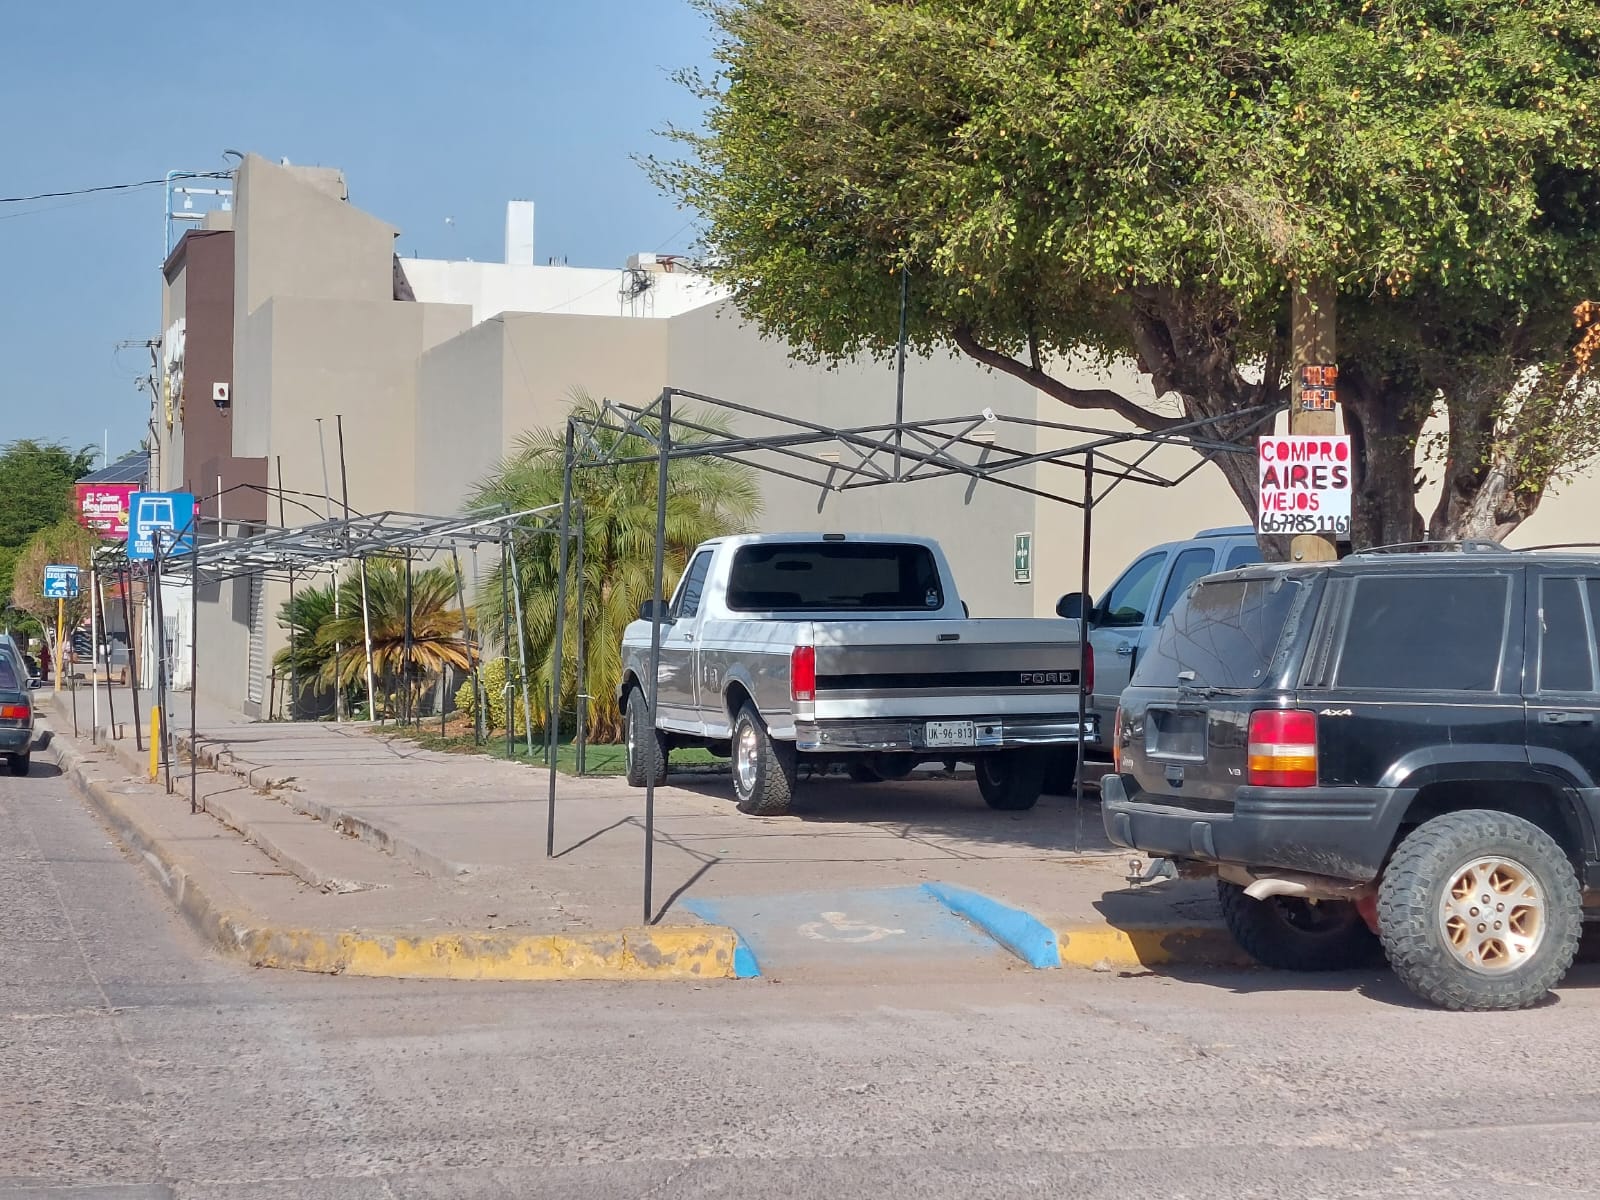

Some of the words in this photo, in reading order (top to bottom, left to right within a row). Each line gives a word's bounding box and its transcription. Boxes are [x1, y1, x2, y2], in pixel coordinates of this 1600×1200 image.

[1261, 441, 1349, 462] COMPRO
[1261, 464, 1349, 490] AIRES
[1261, 492, 1320, 511] VIEJOS
[1020, 672, 1072, 684] FORD
[928, 727, 973, 740] UK-96-813
